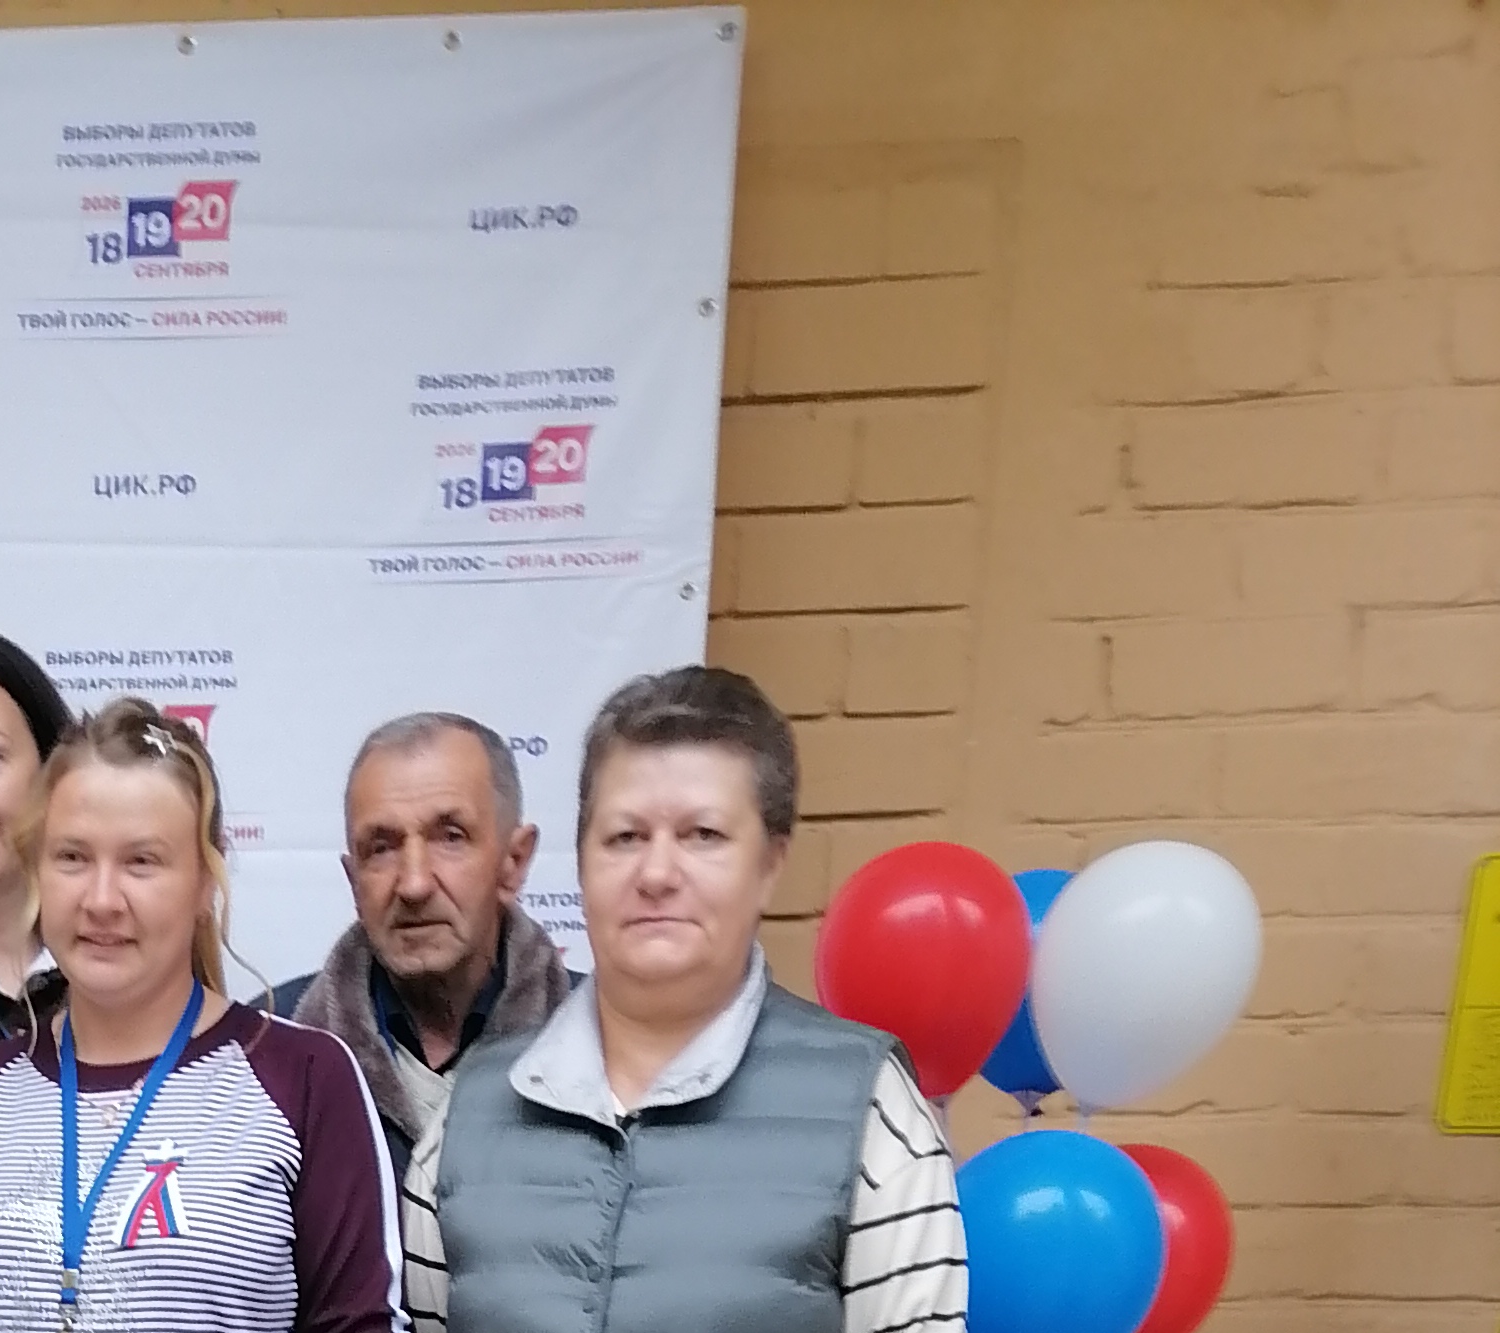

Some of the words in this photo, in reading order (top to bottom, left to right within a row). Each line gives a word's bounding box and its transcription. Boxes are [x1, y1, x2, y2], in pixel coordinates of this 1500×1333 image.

[62, 124, 144, 141] ВЫБОРЫ
[149, 121, 256, 141] ДЕПУТАТОВ
[470, 203, 579, 233] ЦИК.РФ
[86, 231, 123, 264] 18
[131, 210, 171, 248] 19
[178, 193, 227, 230] 20
[133, 262, 229, 278] СЕНТЯБРЯ
[17, 310, 67, 329] ТВОЙ
[71, 312, 131, 328] ГОЛОС
[152, 311, 202, 327] СИЛА
[441, 478, 477, 509] 18
[487, 456, 526, 491] 19
[533, 438, 582, 474] 20
[93, 473, 197, 499] ЦИК.РФ
[46, 651, 123, 665] ВЫБОРЫ
[128, 650, 233, 667] ДЕПУТАТОВ
[53, 674, 187, 691] СУДАРСТВЕННОЙ
[193, 677, 237, 690] ДУМЫ
